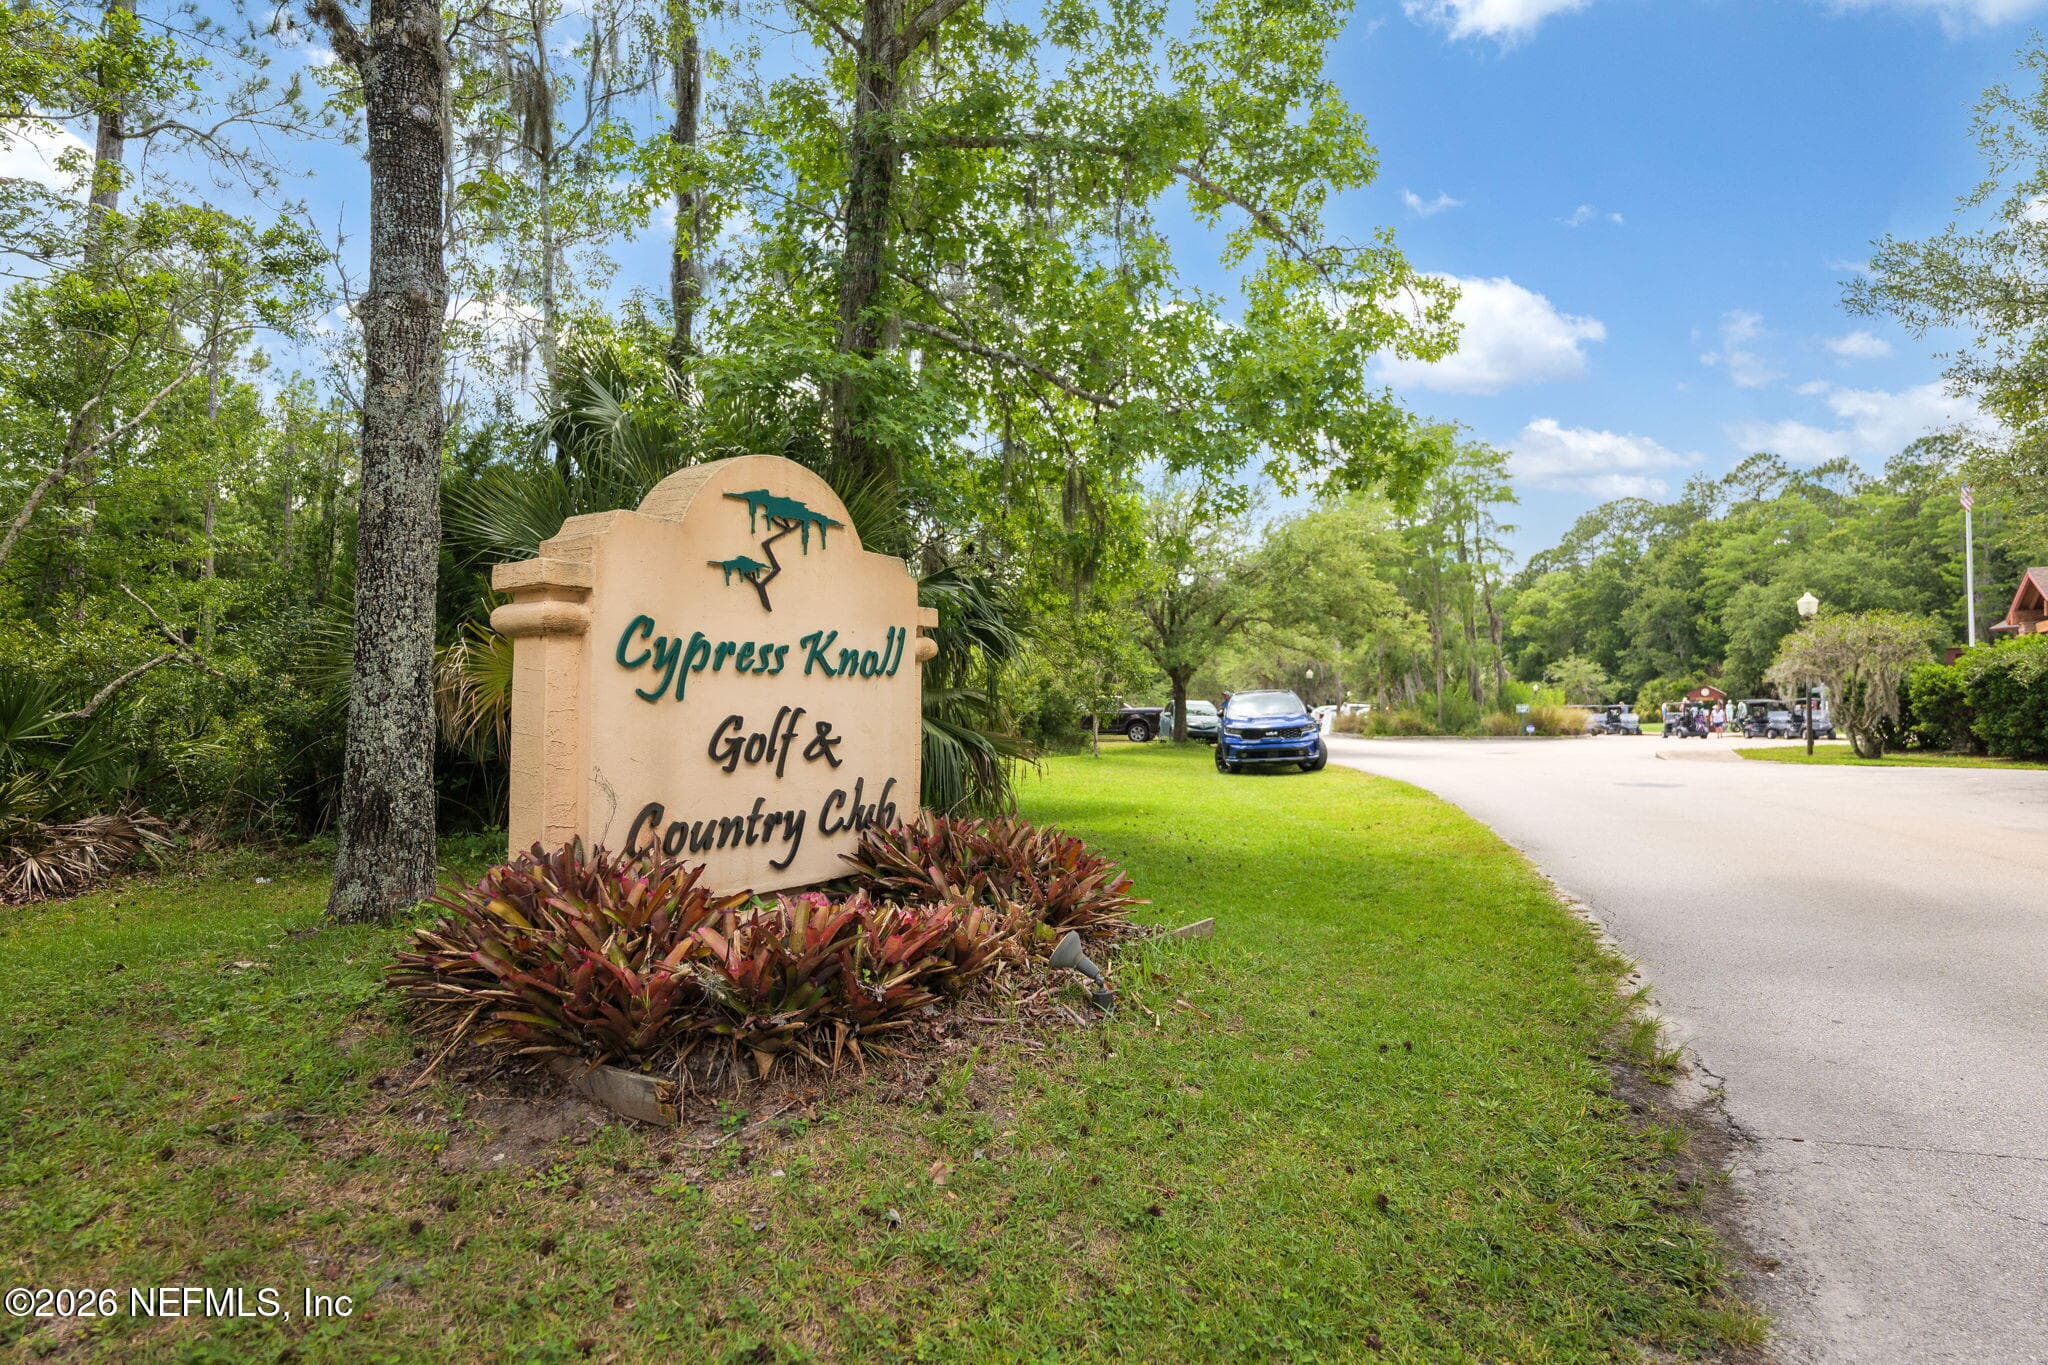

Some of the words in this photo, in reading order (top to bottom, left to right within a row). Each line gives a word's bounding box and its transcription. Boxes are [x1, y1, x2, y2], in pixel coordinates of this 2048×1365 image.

[616, 614, 789, 701] Cypress
[800, 626, 906, 677] Knoll
[708, 706, 806, 777] Golf
[803, 721, 843, 768] &
[627, 797, 806, 869] Country
[818, 776, 897, 834] Club
